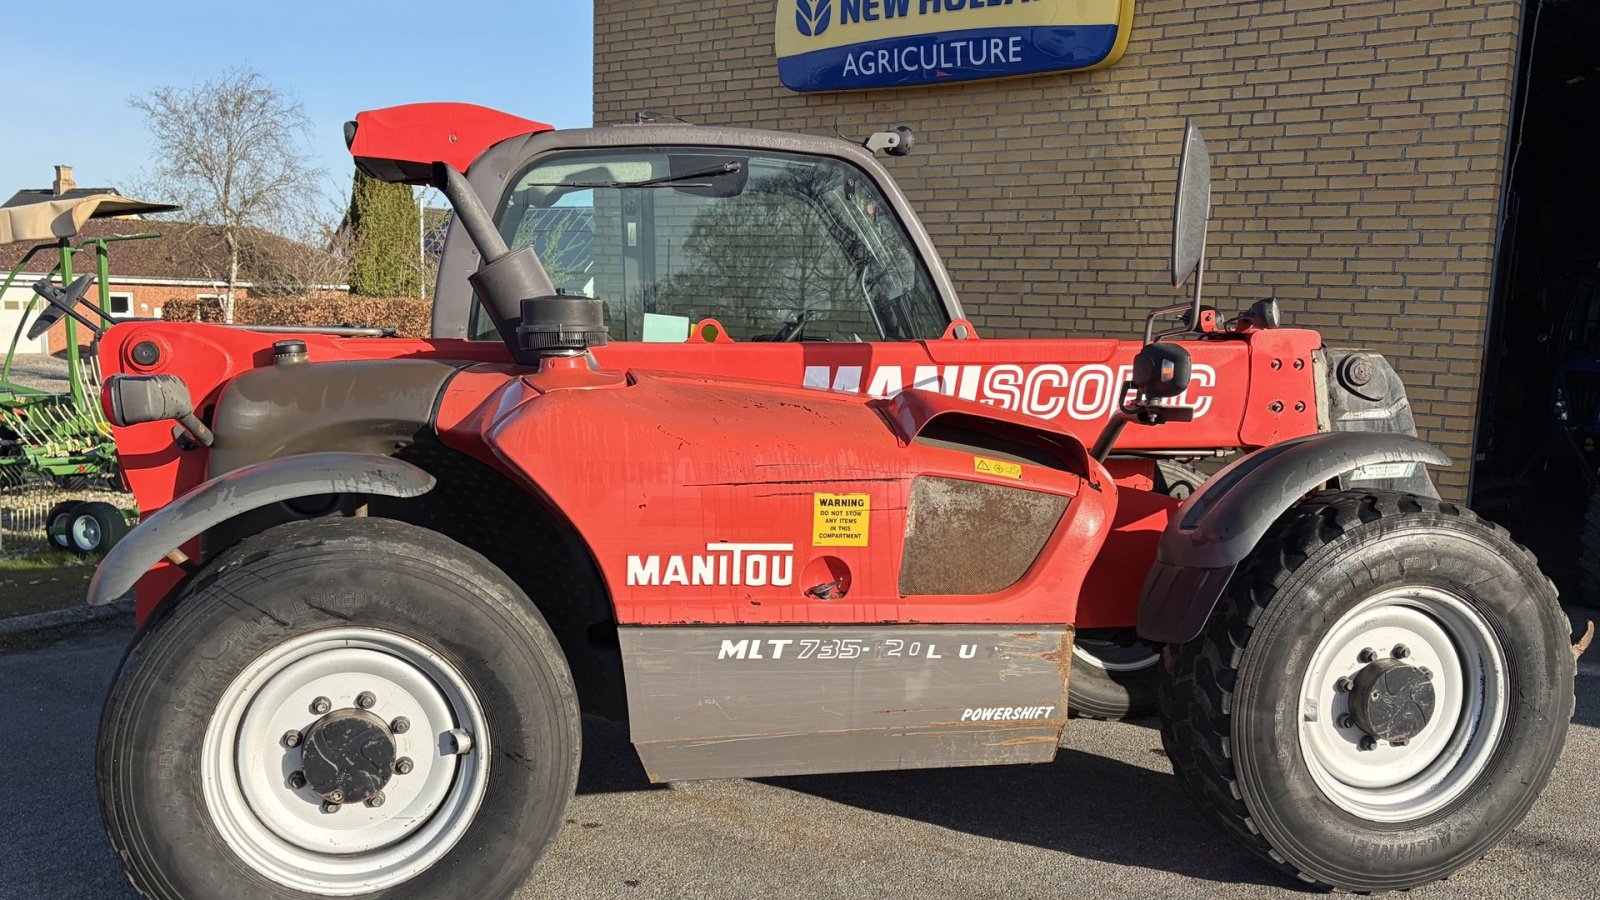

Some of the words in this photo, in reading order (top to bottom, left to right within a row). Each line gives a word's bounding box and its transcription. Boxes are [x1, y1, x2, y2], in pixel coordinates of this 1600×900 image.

[840, 0, 908, 24] NEW
[842, 36, 1022, 77] AGRICULTURE
[819, 498, 865, 507] WARNING
[626, 543, 794, 586] MANITOU
[717, 639, 793, 659] MLT
[961, 706, 1055, 721] POWERSHIFT
